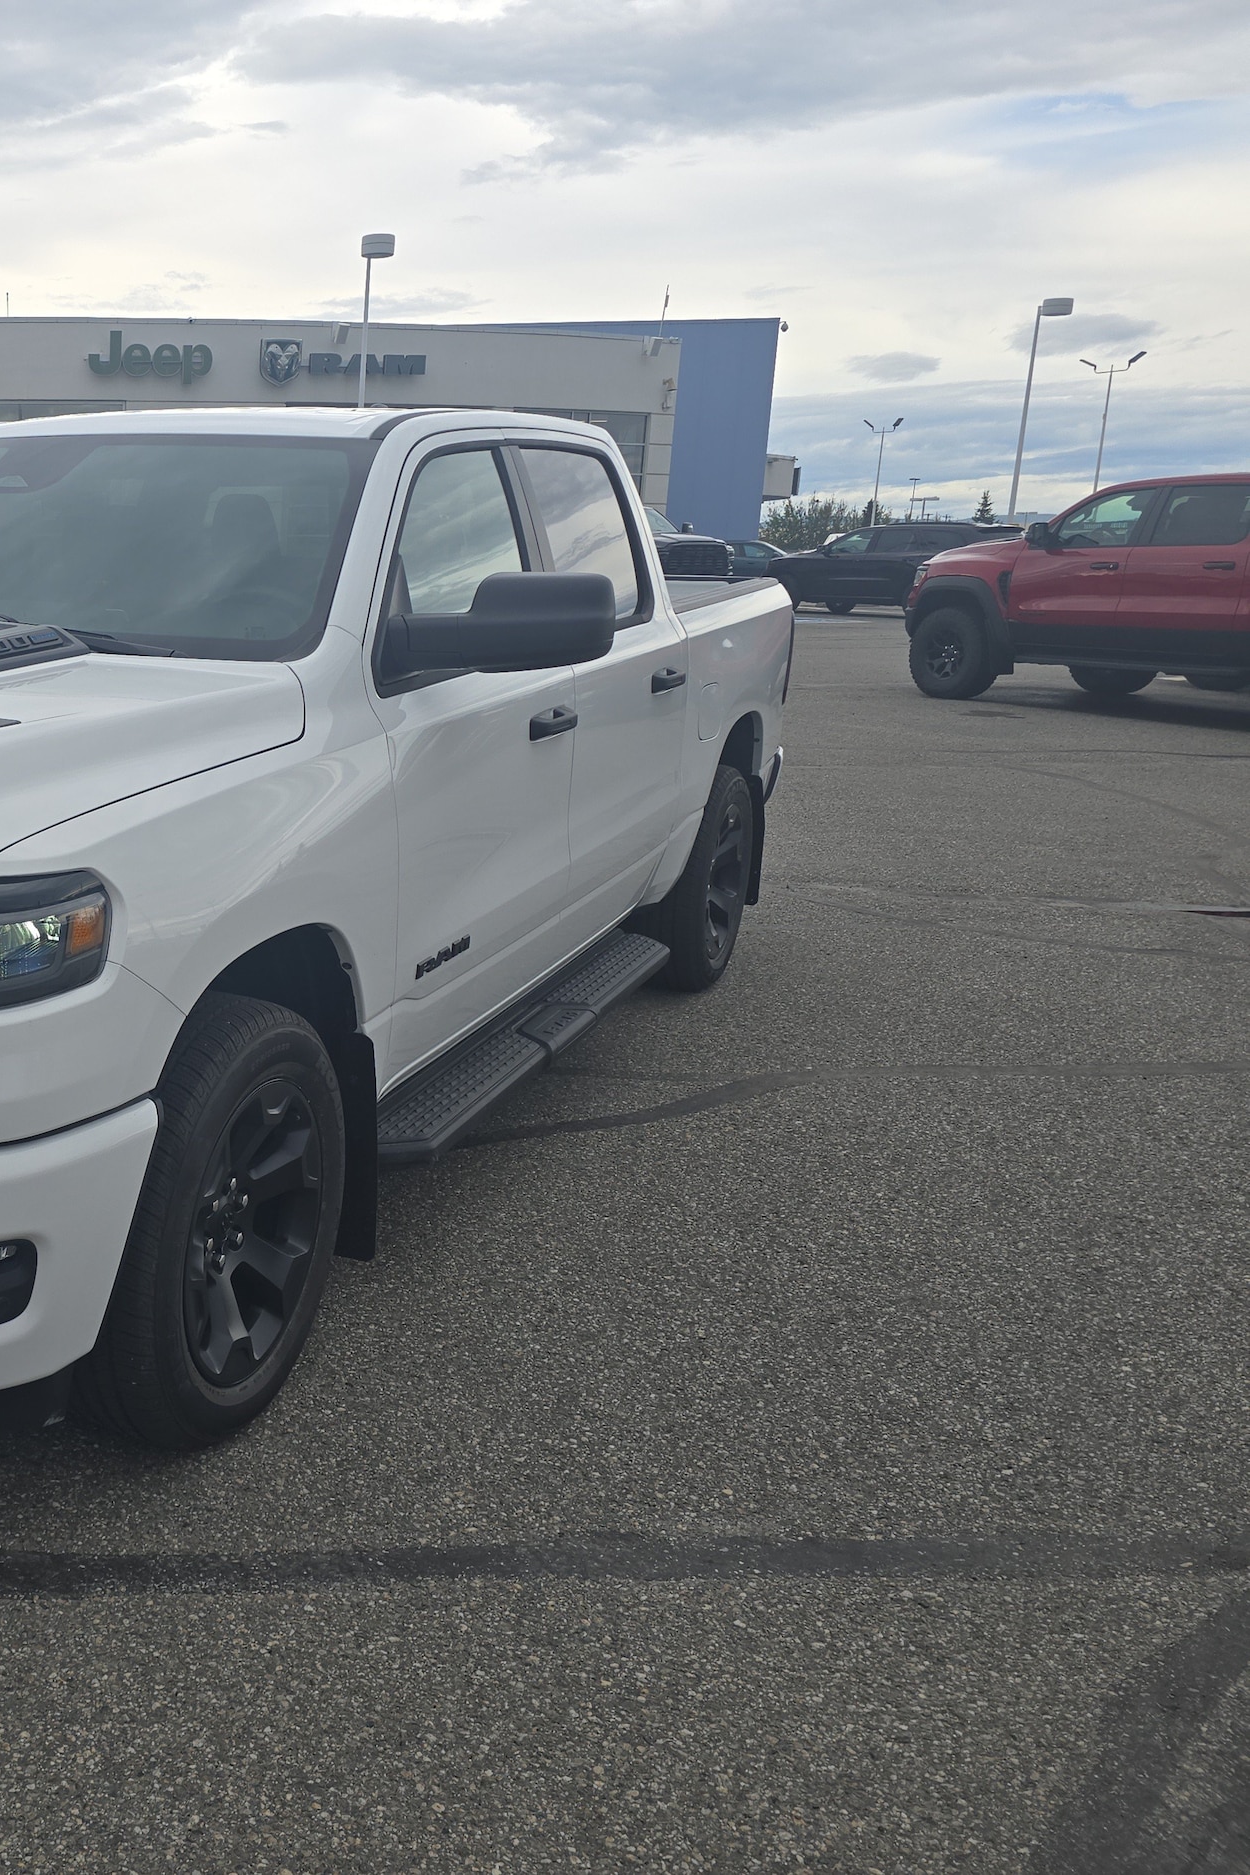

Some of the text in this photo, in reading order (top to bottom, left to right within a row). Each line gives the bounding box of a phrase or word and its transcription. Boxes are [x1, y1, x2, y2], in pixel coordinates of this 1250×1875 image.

[88, 330, 213, 384] Jeep
[309, 352, 427, 375] RAM
[414, 933, 471, 980] RAM
